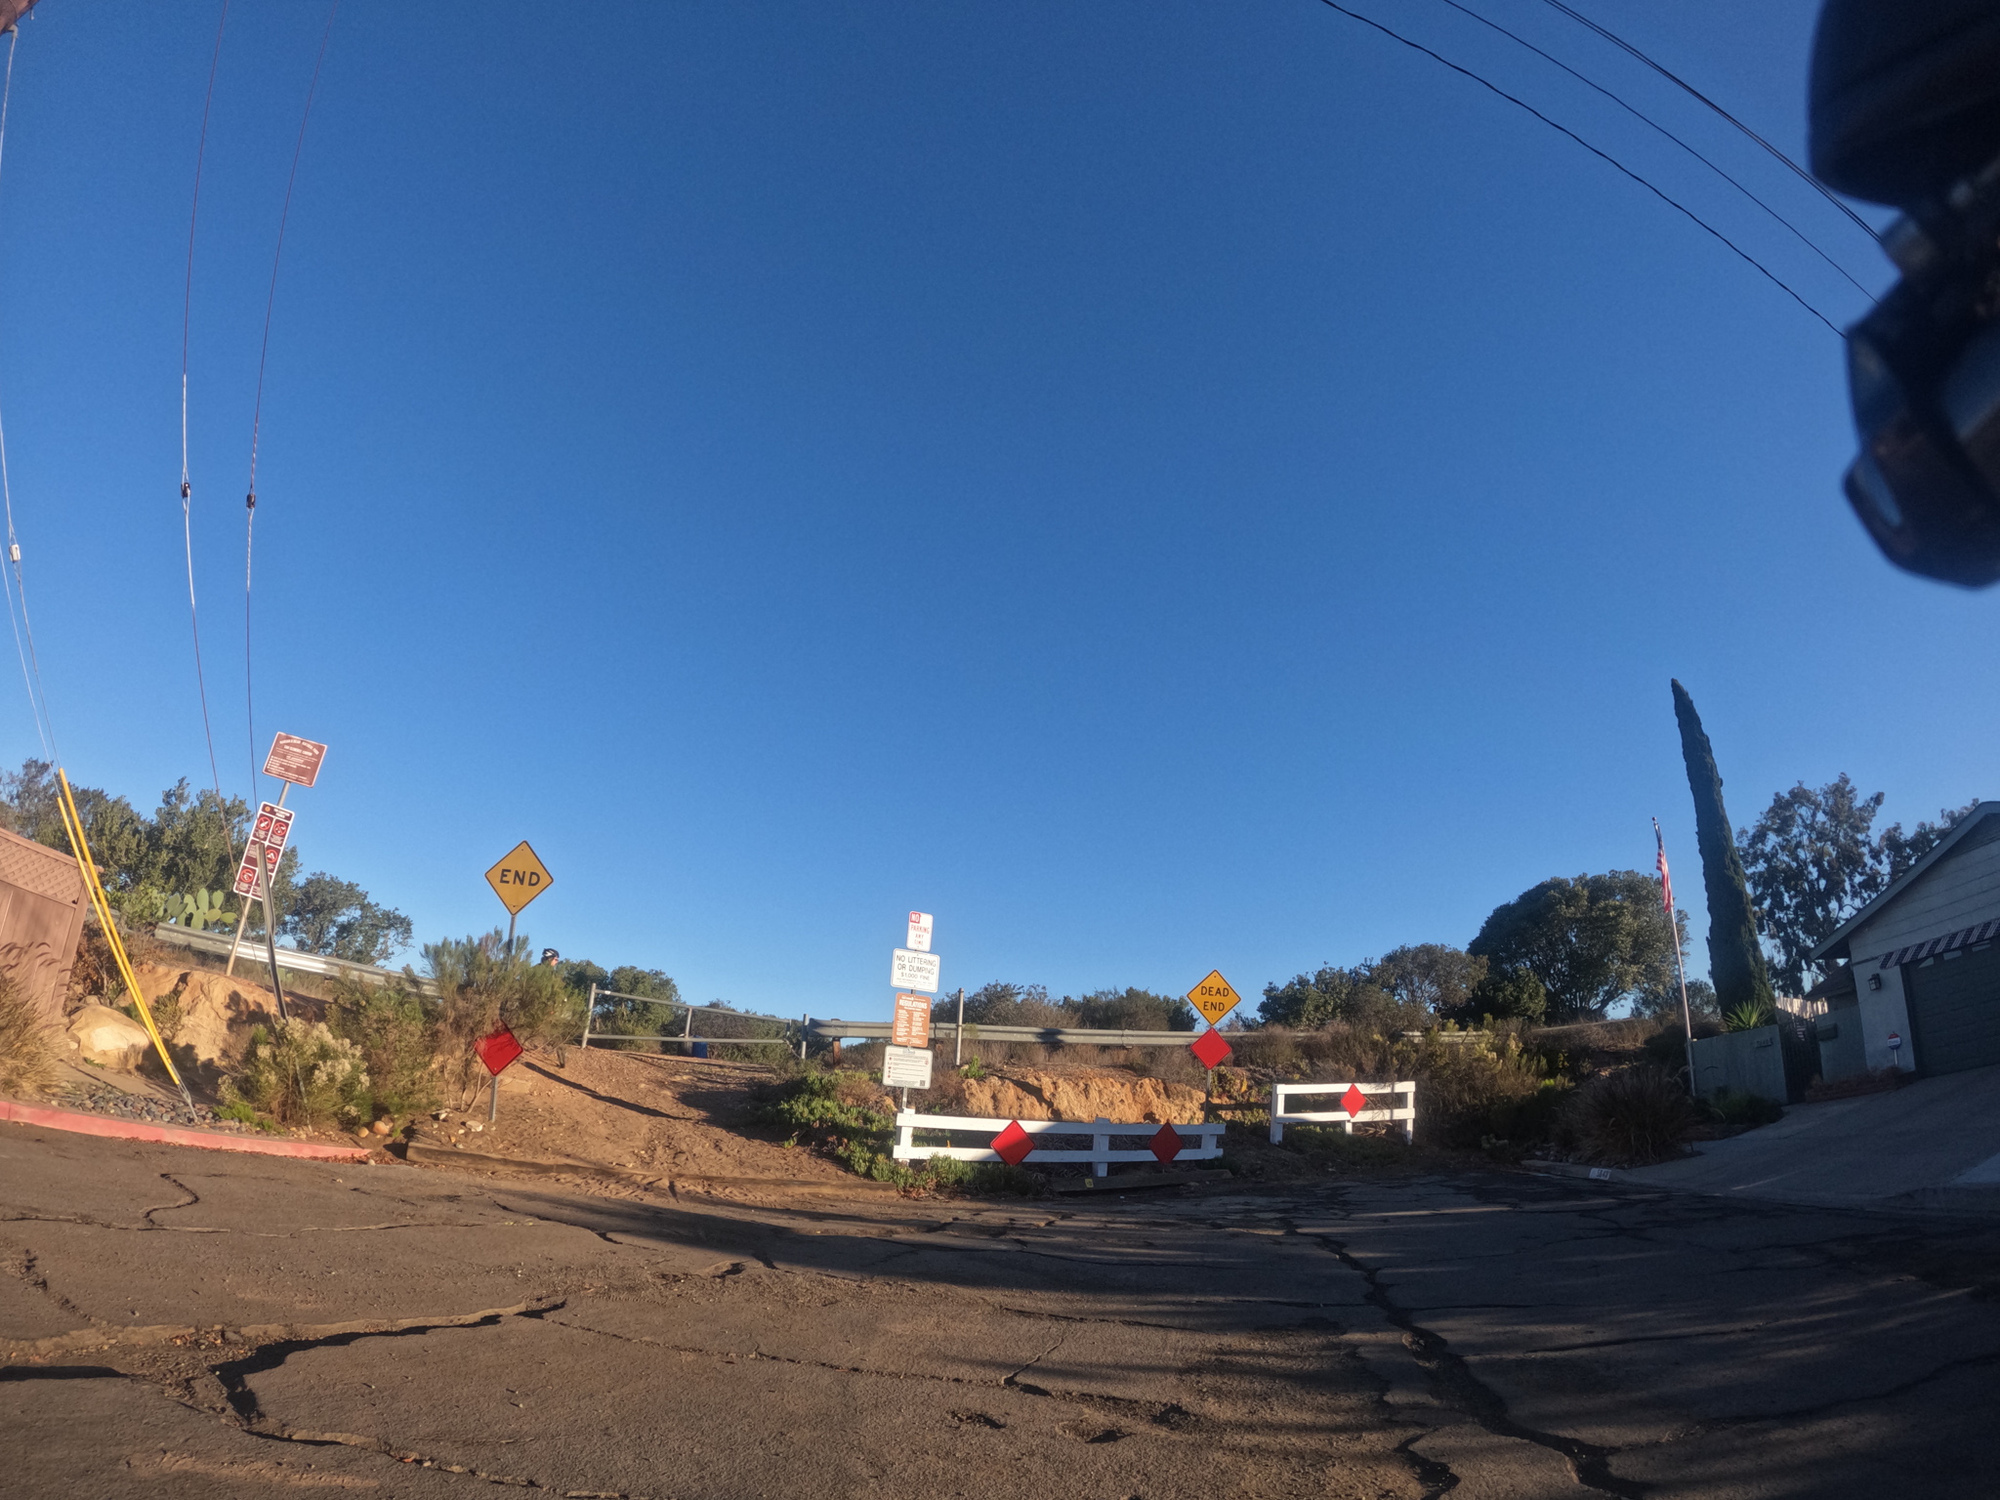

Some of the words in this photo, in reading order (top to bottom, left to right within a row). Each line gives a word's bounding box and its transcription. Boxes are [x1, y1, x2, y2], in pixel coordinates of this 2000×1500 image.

[500, 869, 541, 886] END
[911, 913, 920, 922] NO
[911, 924, 929, 934] PARKING
[908, 956, 937, 967] LITTERING
[909, 965, 935, 975] DUMPING
[1200, 986, 1229, 997] DEAD
[1203, 1001, 1225, 1011] END
